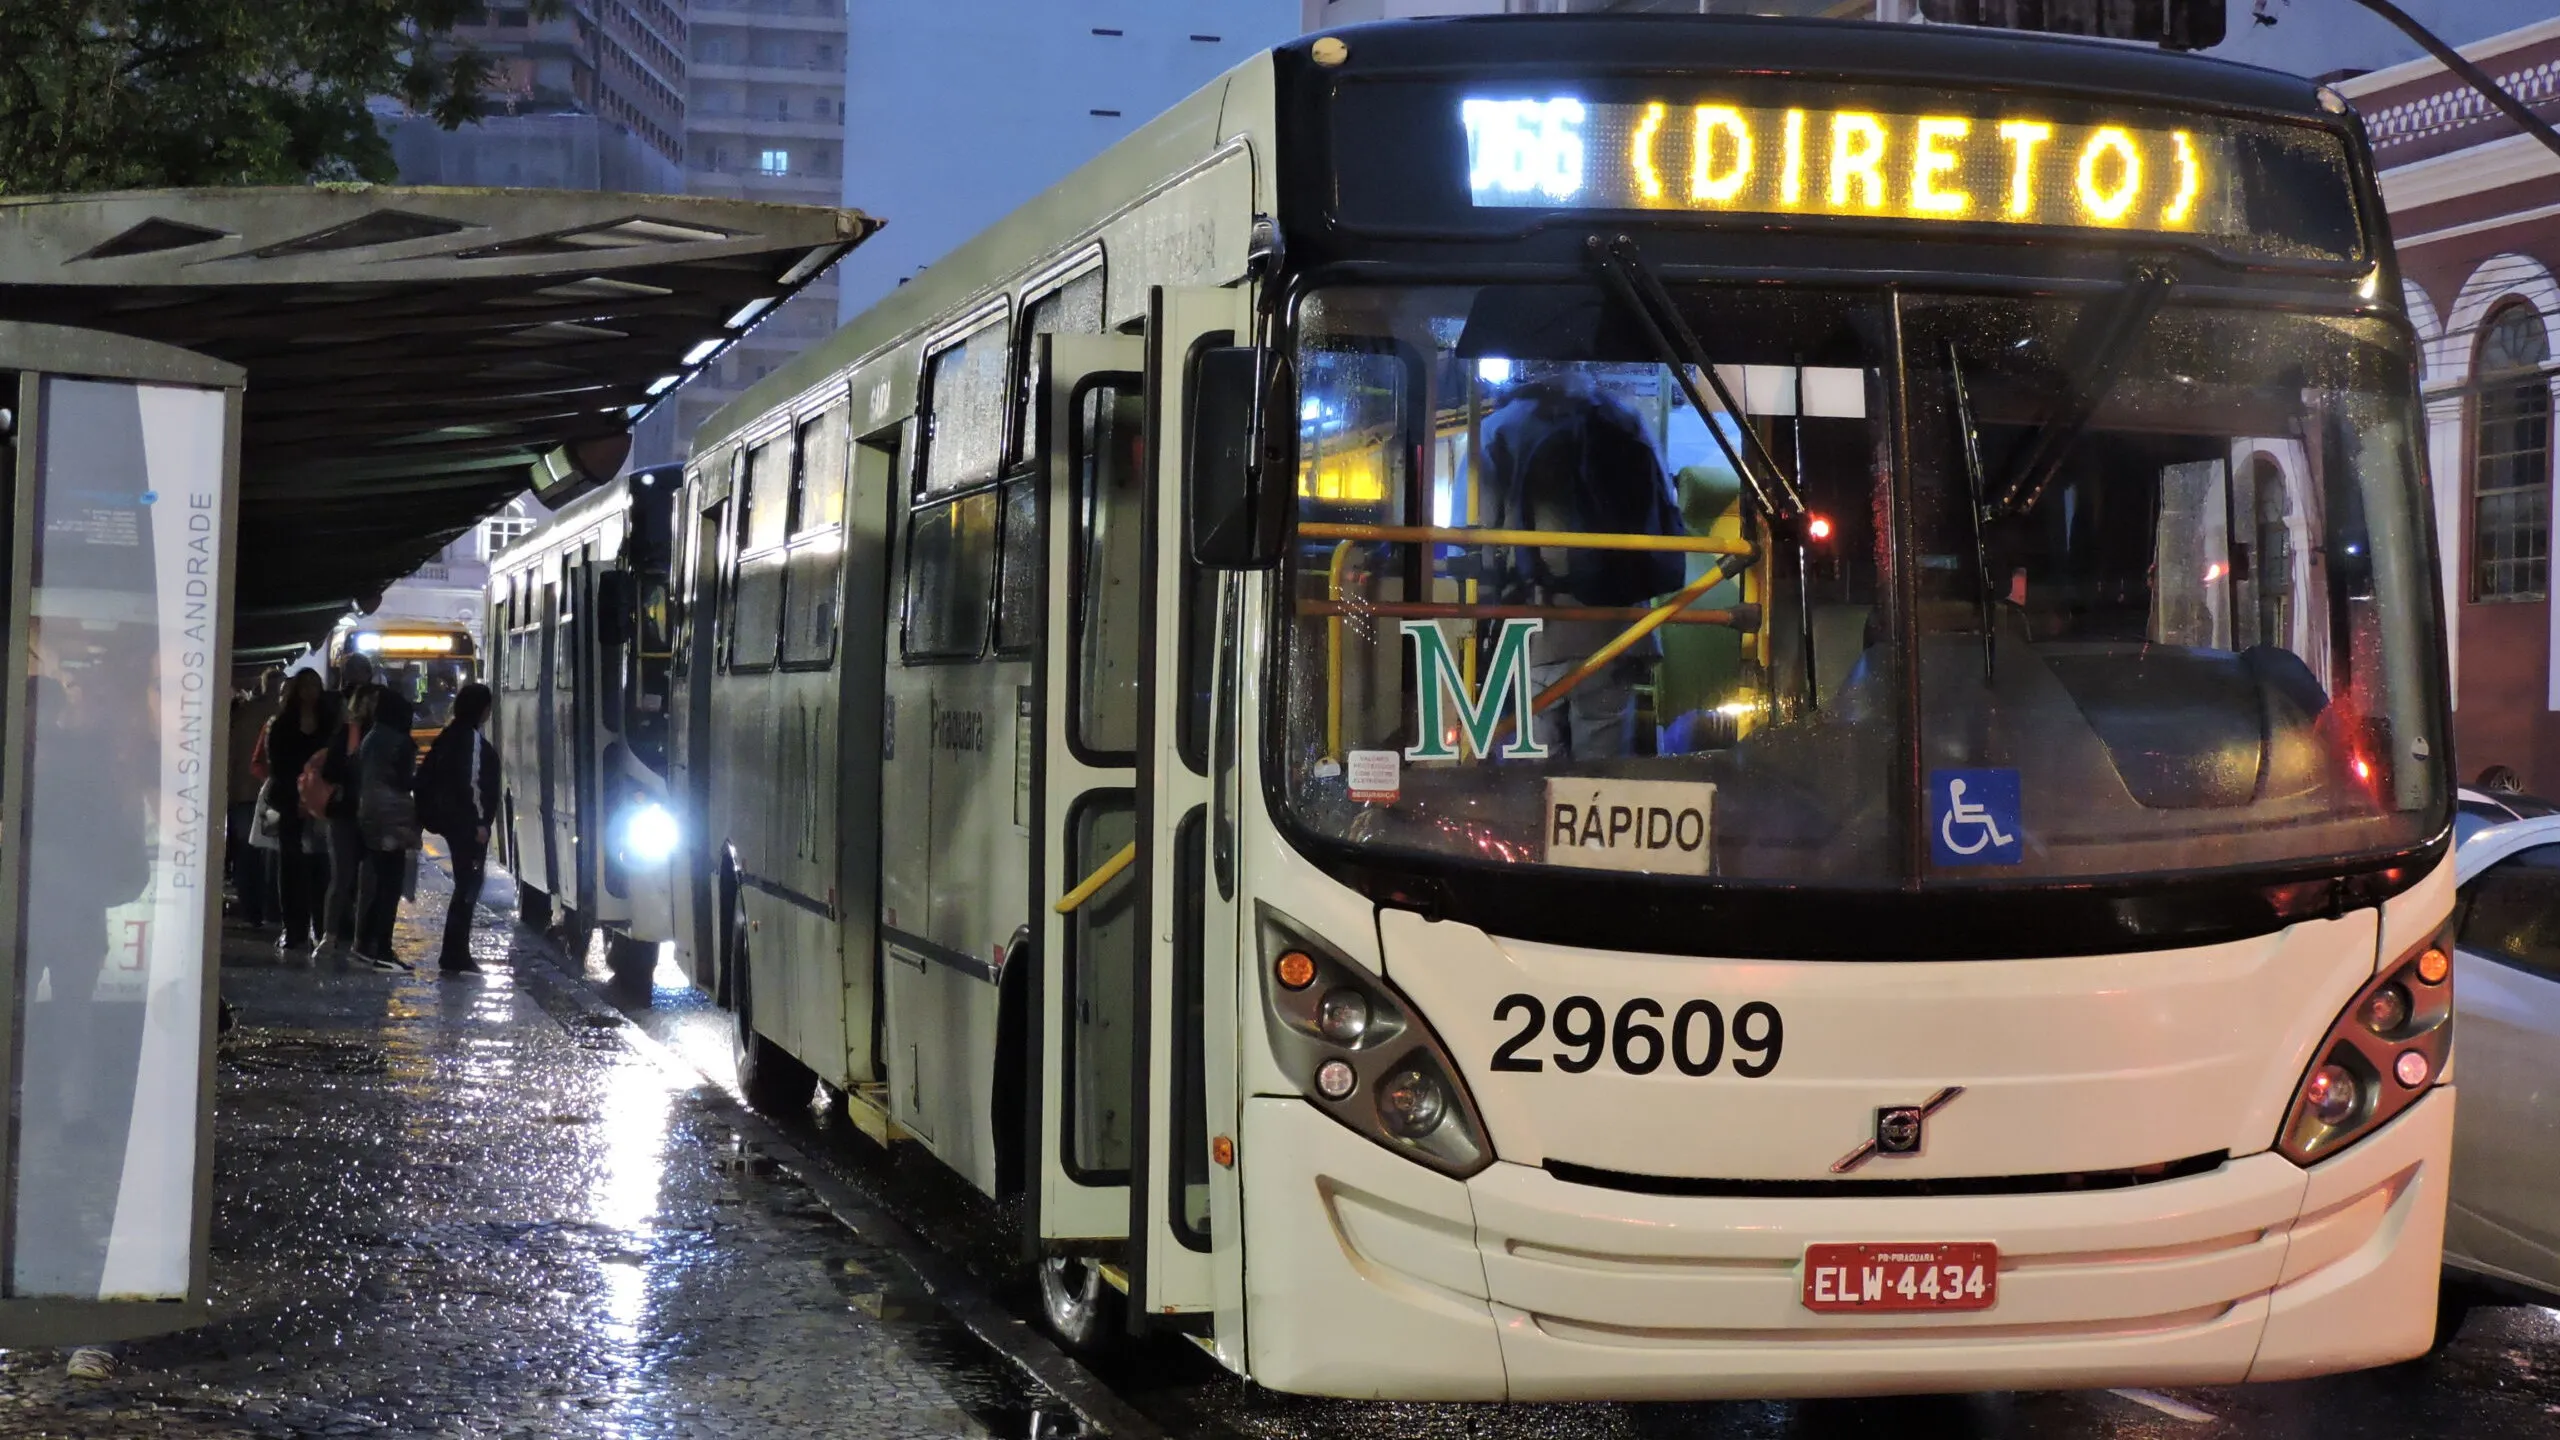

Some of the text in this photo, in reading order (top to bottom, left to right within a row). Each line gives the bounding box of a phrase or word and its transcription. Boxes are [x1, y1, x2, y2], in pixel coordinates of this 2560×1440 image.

[1632, 102, 2198, 222] (DIRETO)
[173, 492, 212, 889] PRAÇA SANTOS ANDRADE
[1400, 617, 1549, 761] M
[1552, 791, 1704, 852] RÁPIDO
[1490, 993, 1784, 1079] 29609
